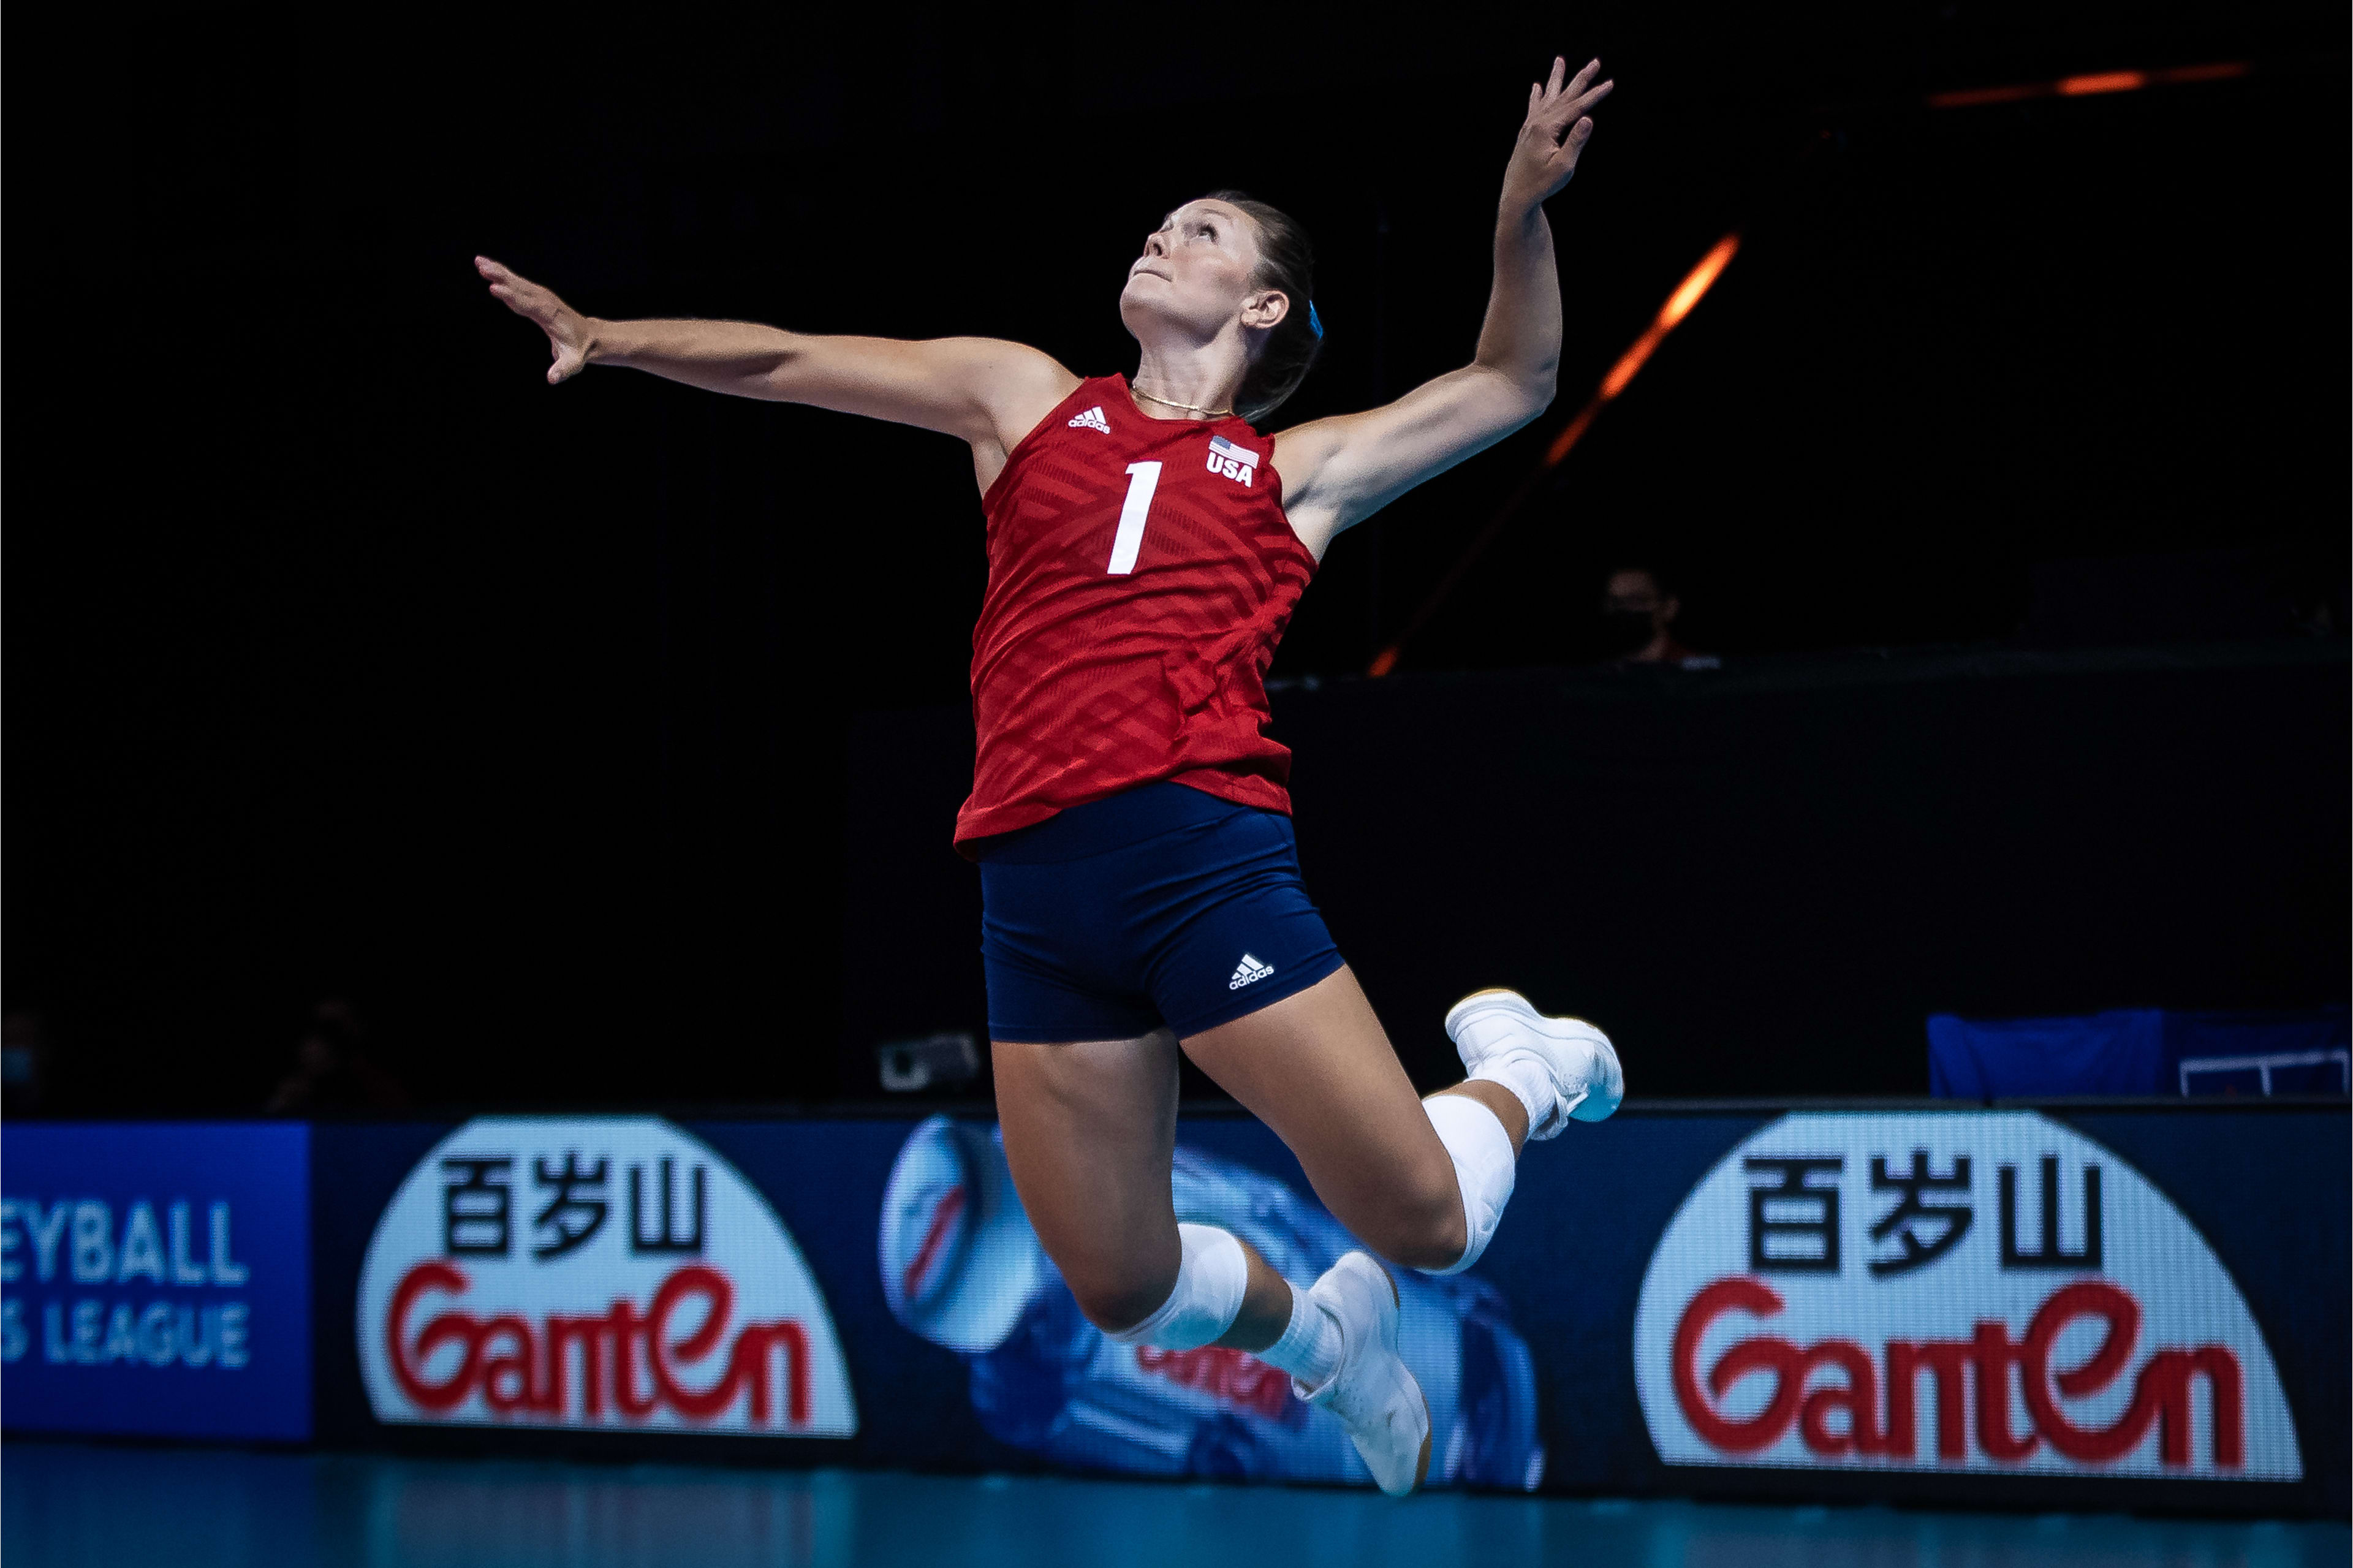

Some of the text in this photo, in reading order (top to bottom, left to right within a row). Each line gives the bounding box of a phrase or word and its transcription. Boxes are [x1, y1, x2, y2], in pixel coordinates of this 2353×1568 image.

[1068, 419, 1110, 434] adidas
[1206, 451, 1252, 488] USA
[1107, 461, 1163, 575] 1
[1229, 966, 1274, 990] adidas
[441, 1148, 708, 1263] 百岁山
[1741, 1148, 2104, 1279] 百岁山
[45, 1300, 249, 1369] LEAGUE
[387, 1259, 811, 1425] Ganten
[1672, 1276, 2245, 1468] Ganten
